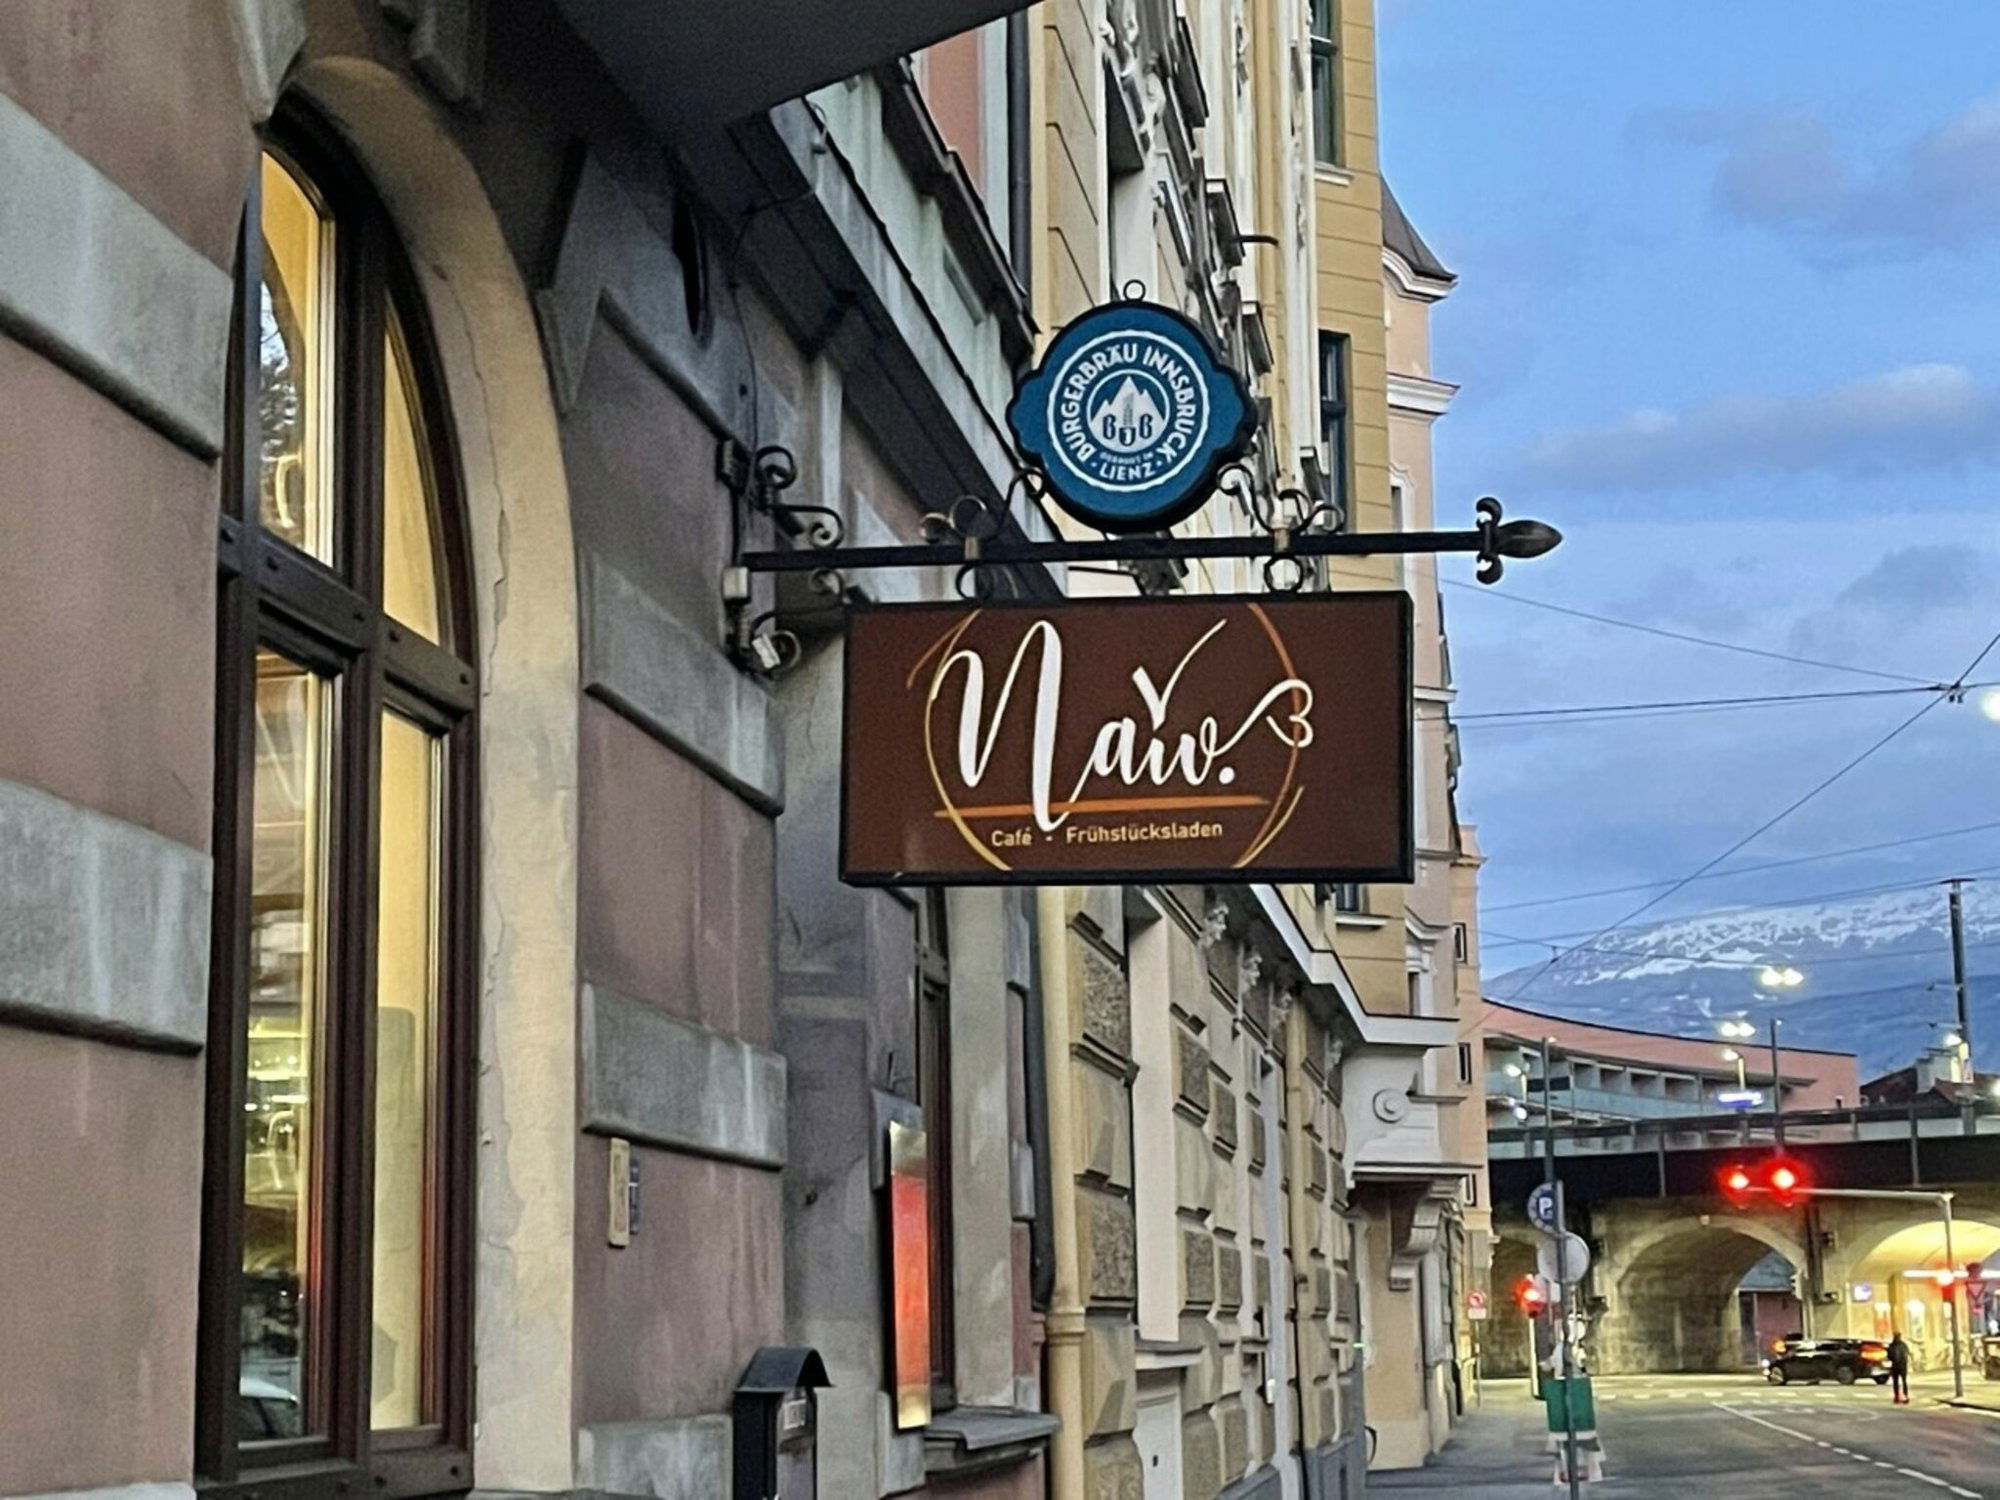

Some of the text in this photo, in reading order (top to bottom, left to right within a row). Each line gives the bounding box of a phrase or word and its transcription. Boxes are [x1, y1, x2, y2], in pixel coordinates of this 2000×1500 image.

[1142, 345, 1197, 463] INNSBRUCK
[1099, 462, 1156, 481] LIENZ
[991, 827, 1032, 847] Café
[1066, 821, 1223, 844] Frühstücksladen
